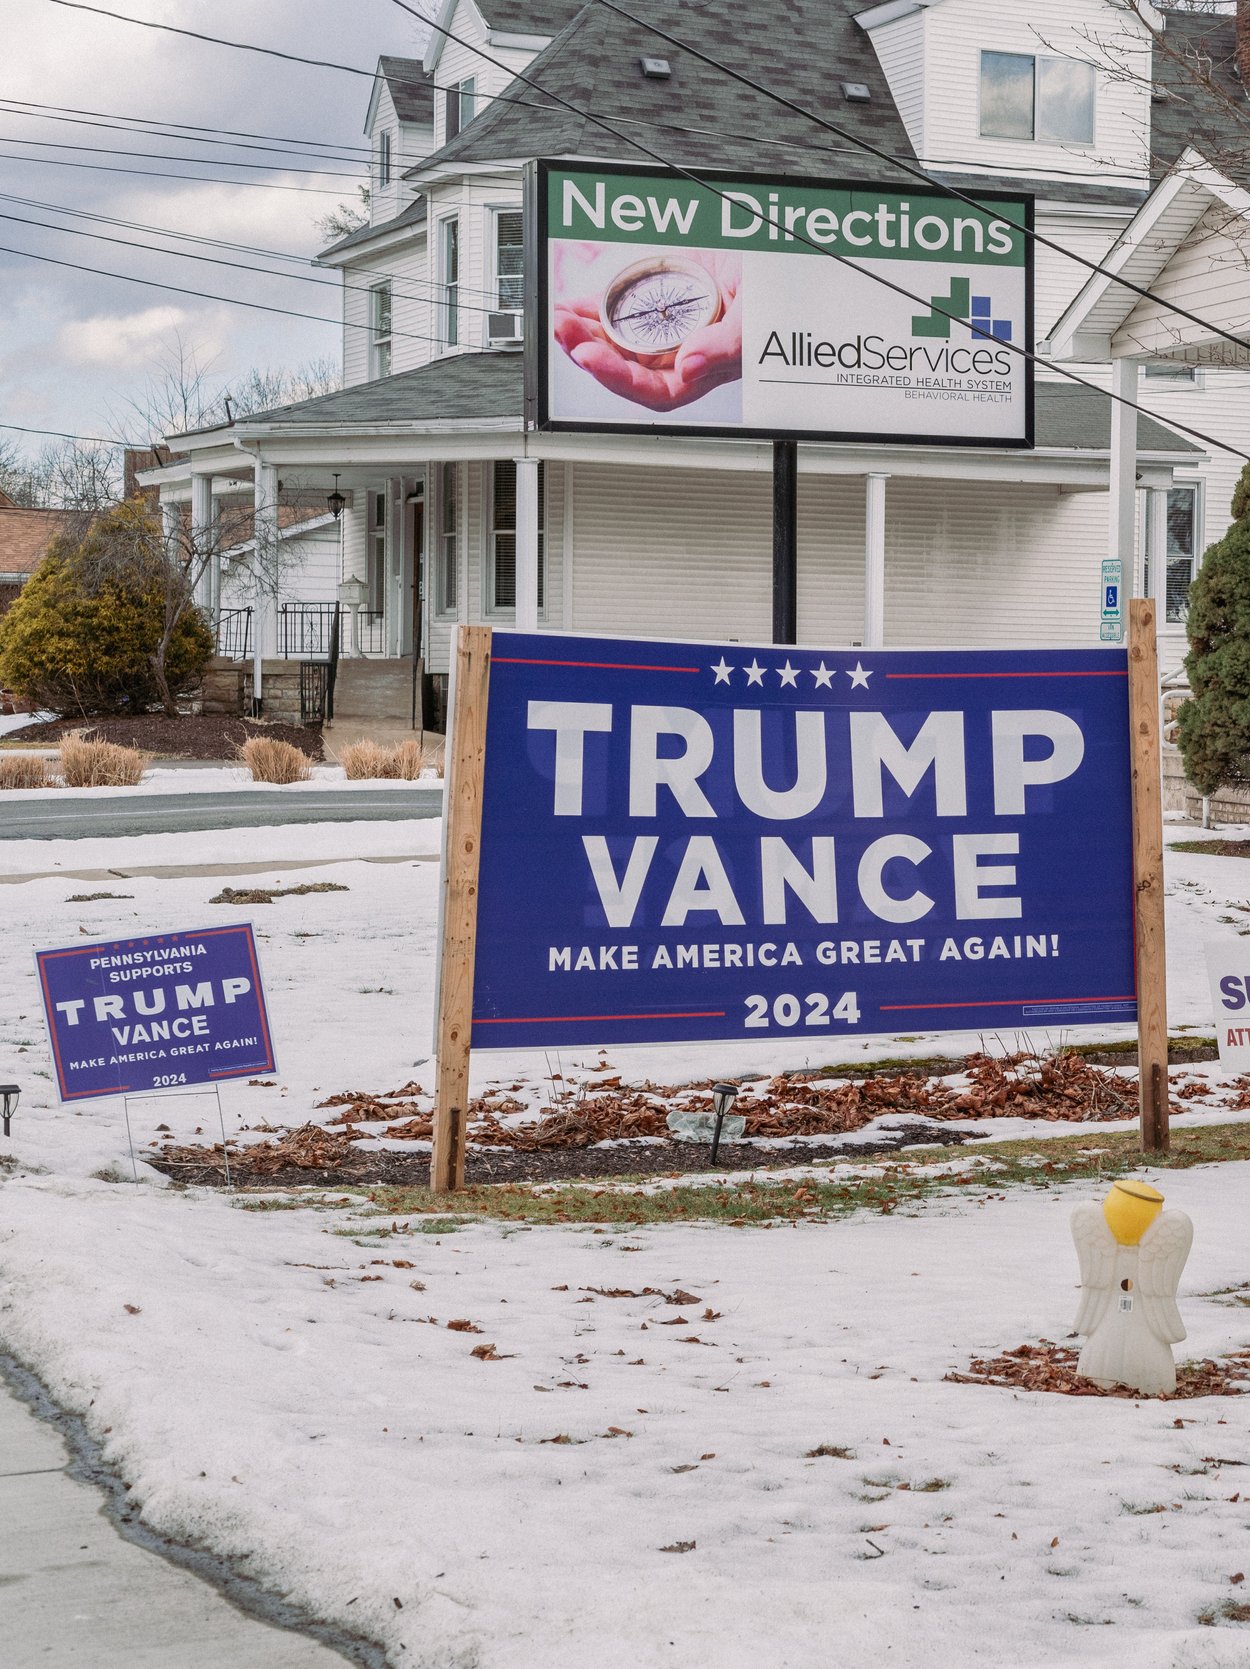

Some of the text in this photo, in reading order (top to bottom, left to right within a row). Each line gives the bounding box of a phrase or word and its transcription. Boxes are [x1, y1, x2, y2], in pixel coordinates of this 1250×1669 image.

[561, 179, 1014, 255] New Directions
[758, 330, 1012, 375] AlliedServices
[836, 373, 1012, 391] INTEGRATED HEALTH SYSTEM
[904, 389, 1012, 403] BEHAVIORAL HEALTH
[526, 699, 1085, 821] TRUMP
[581, 831, 1022, 928] VANCE
[89, 943, 207, 970] PENNSYLVANIA
[548, 934, 1060, 972] MAKE AMERICA GREAT AGAIN!
[109, 961, 194, 984] SUPPORTS
[55, 976, 252, 1026] TRUMP
[743, 991, 861, 1029] 2024
[111, 1014, 210, 1047] VANCE
[69, 1036, 259, 1071] MAKE AMERICA GREAT AGAIN!
[152, 1072, 188, 1088] 2024
